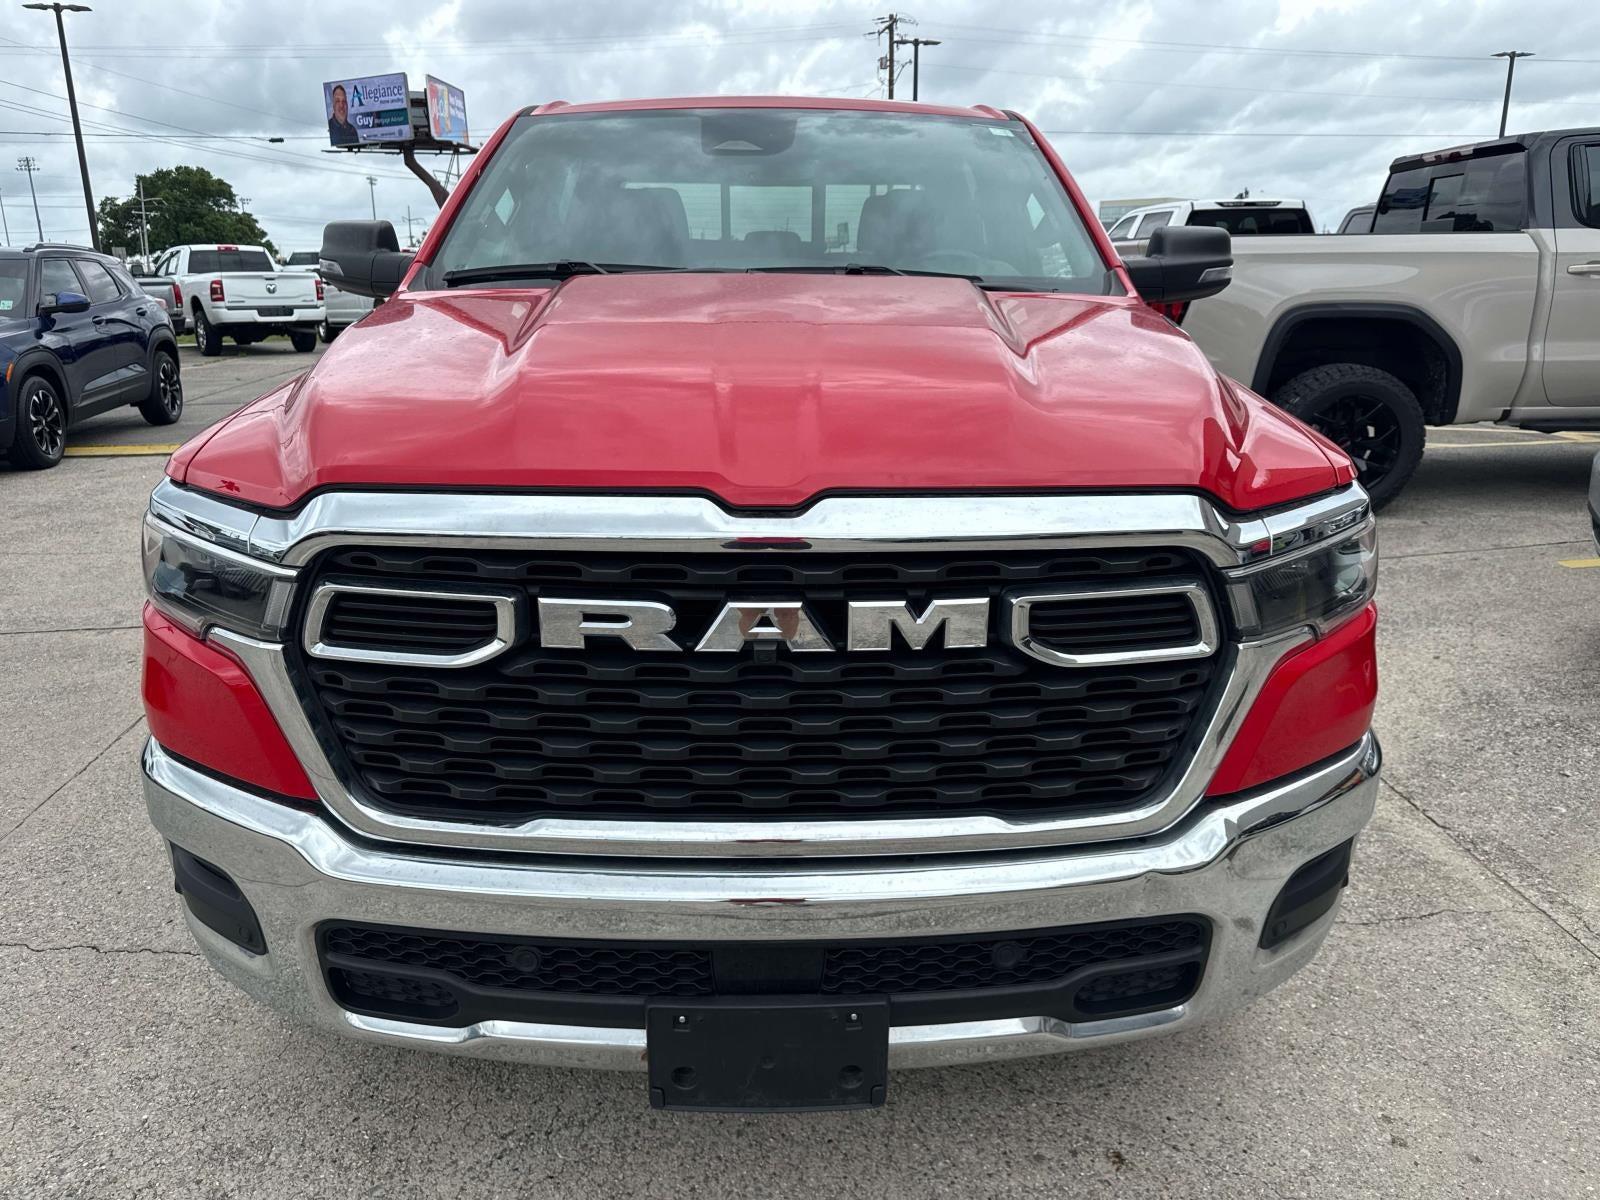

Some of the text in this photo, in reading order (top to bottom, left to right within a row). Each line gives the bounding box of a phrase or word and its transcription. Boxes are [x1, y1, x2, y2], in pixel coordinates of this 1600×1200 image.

[351, 84, 403, 107] Allegiance
[356, 115, 374, 128] Guy
[538, 597, 990, 652] RAM
